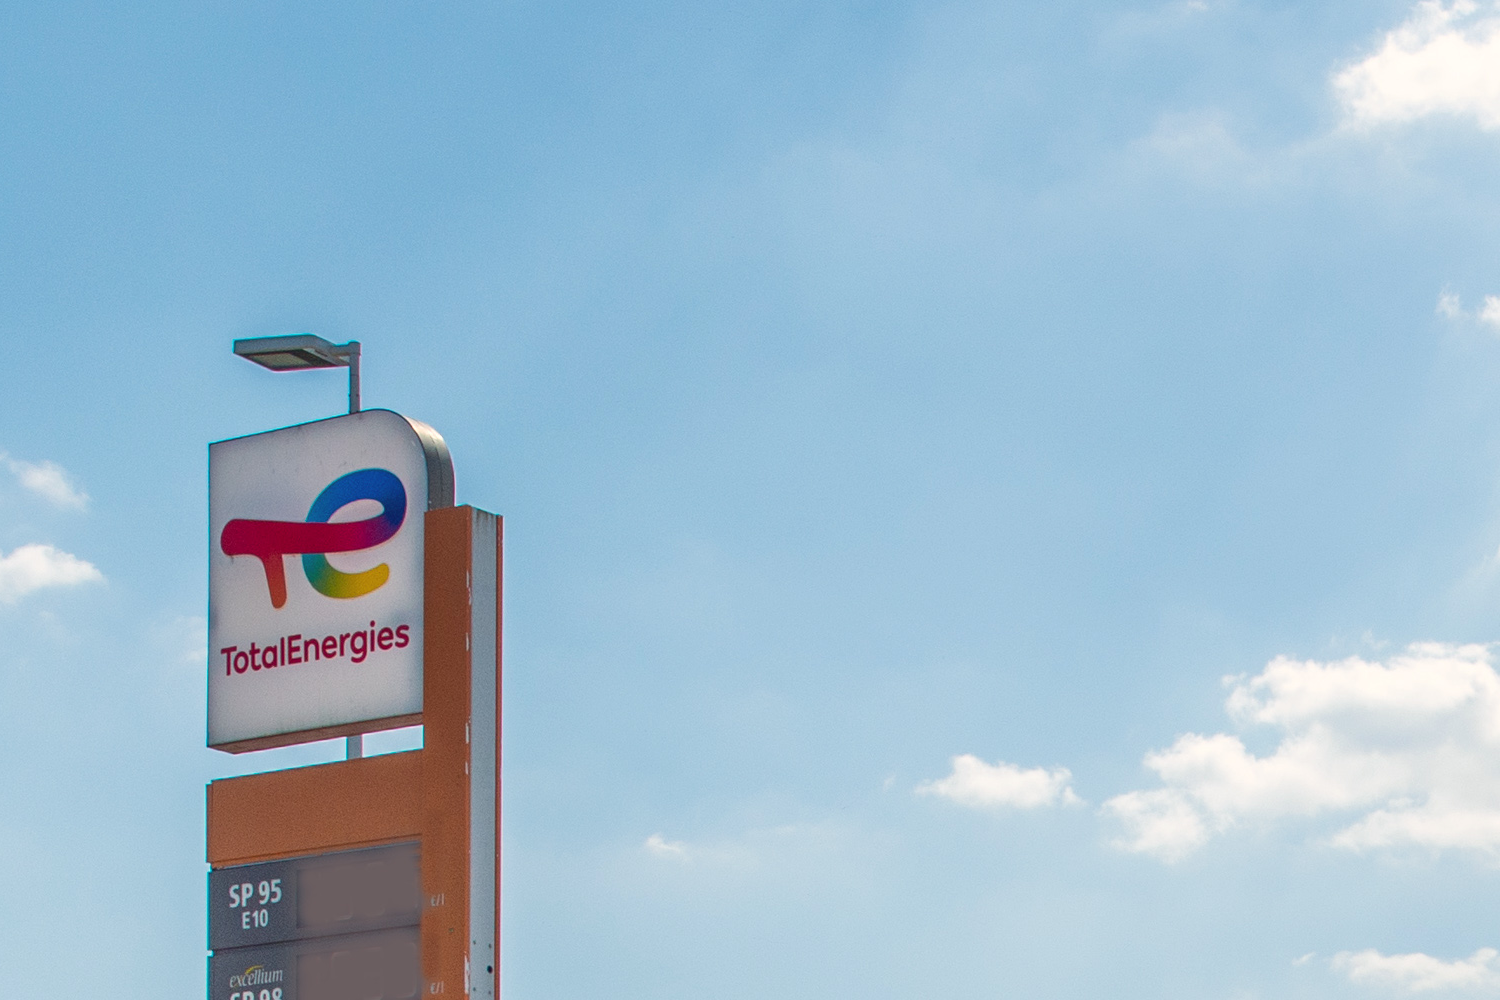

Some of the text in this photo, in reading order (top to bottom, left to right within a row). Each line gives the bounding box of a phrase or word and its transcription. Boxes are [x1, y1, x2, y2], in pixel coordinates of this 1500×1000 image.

[220, 620, 410, 676] TotalEnergies
[229, 878, 282, 908] SP 95
[229, 966, 283, 988] excellium
